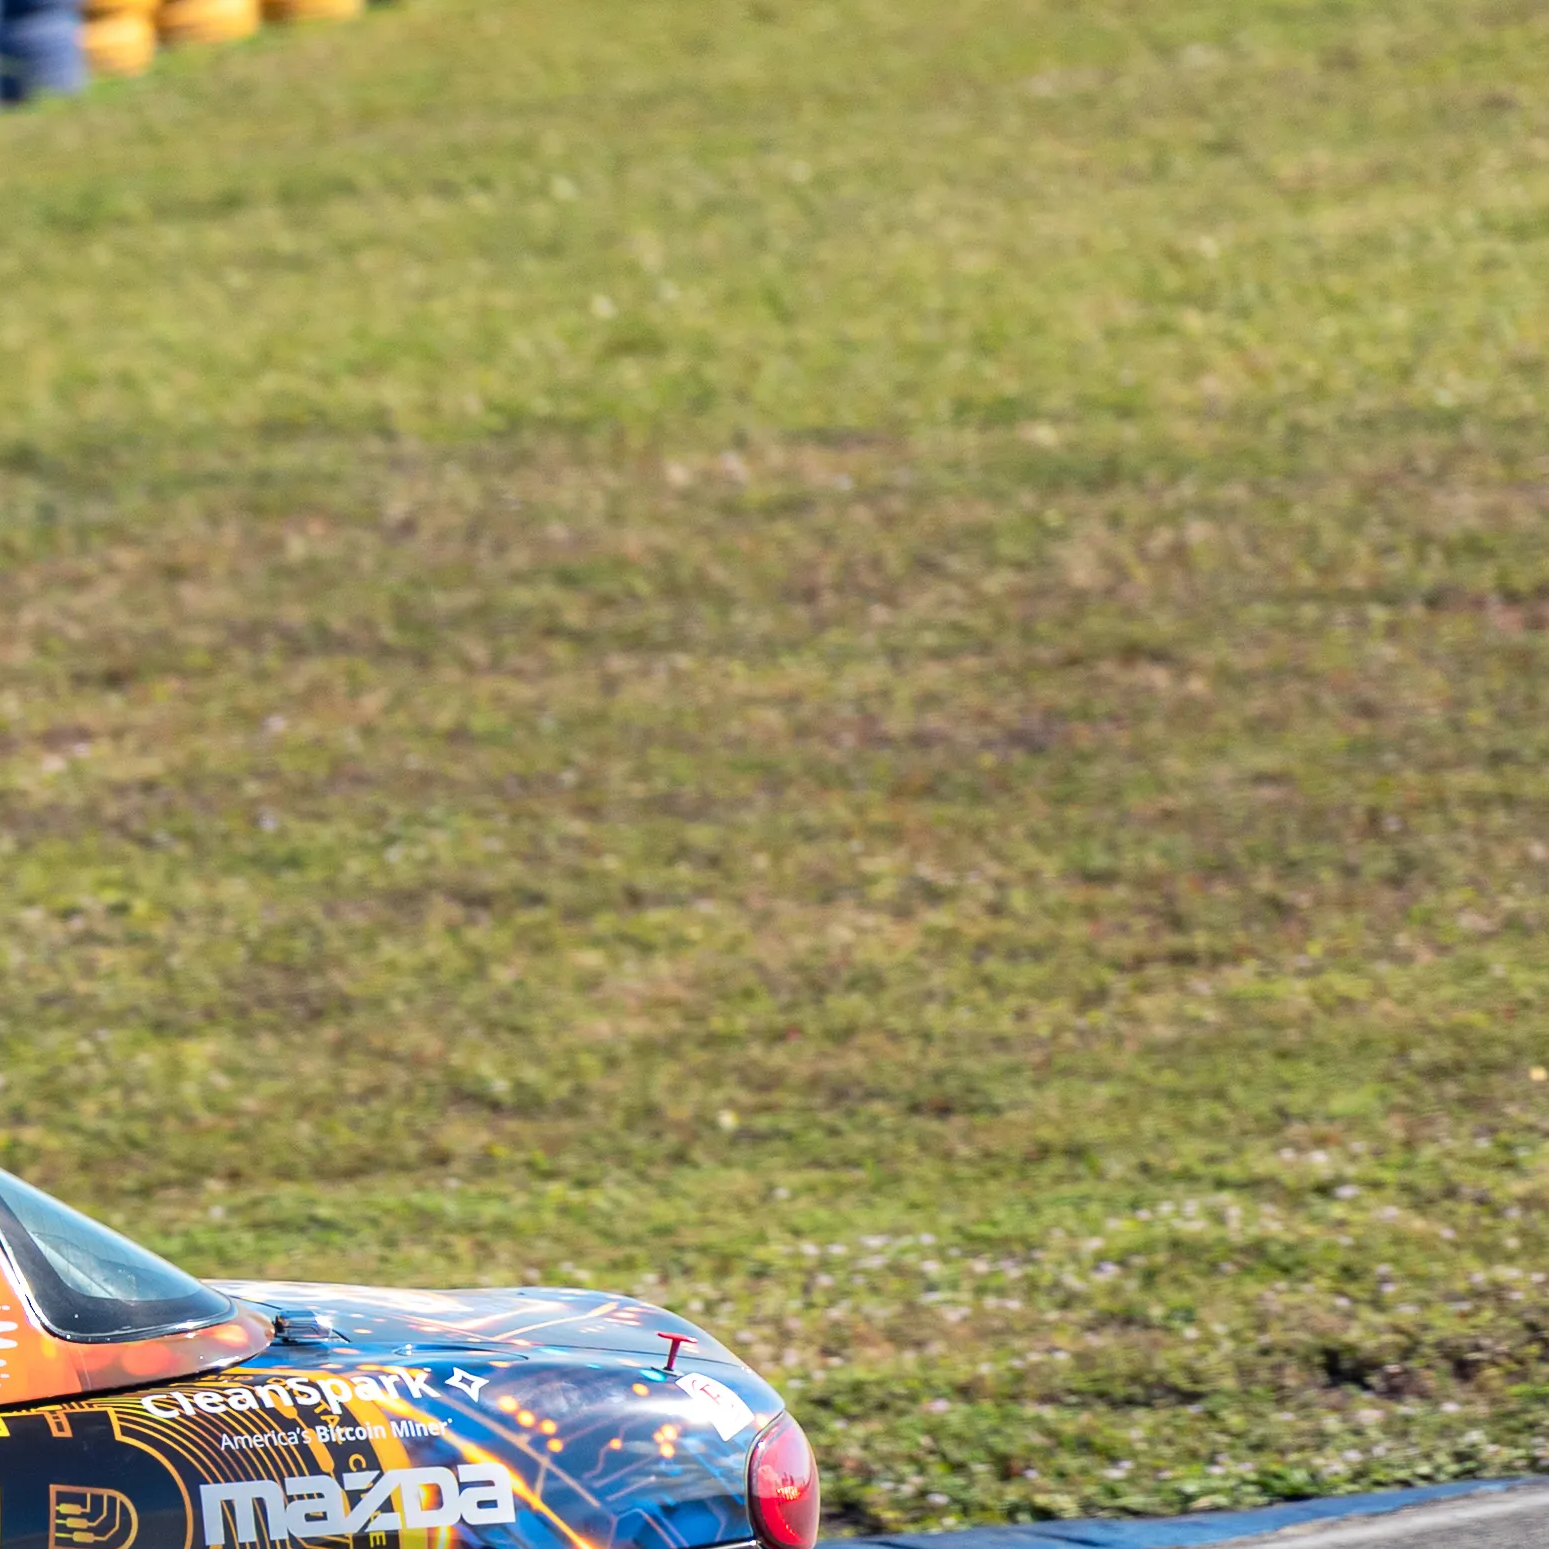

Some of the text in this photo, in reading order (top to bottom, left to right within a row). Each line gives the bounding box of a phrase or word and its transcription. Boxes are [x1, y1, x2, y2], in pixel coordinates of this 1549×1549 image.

[141, 1369, 443, 1420] CleanSpark
[220, 1427, 312, 1451] America's
[316, 1423, 386, 1444] Bitcoin
